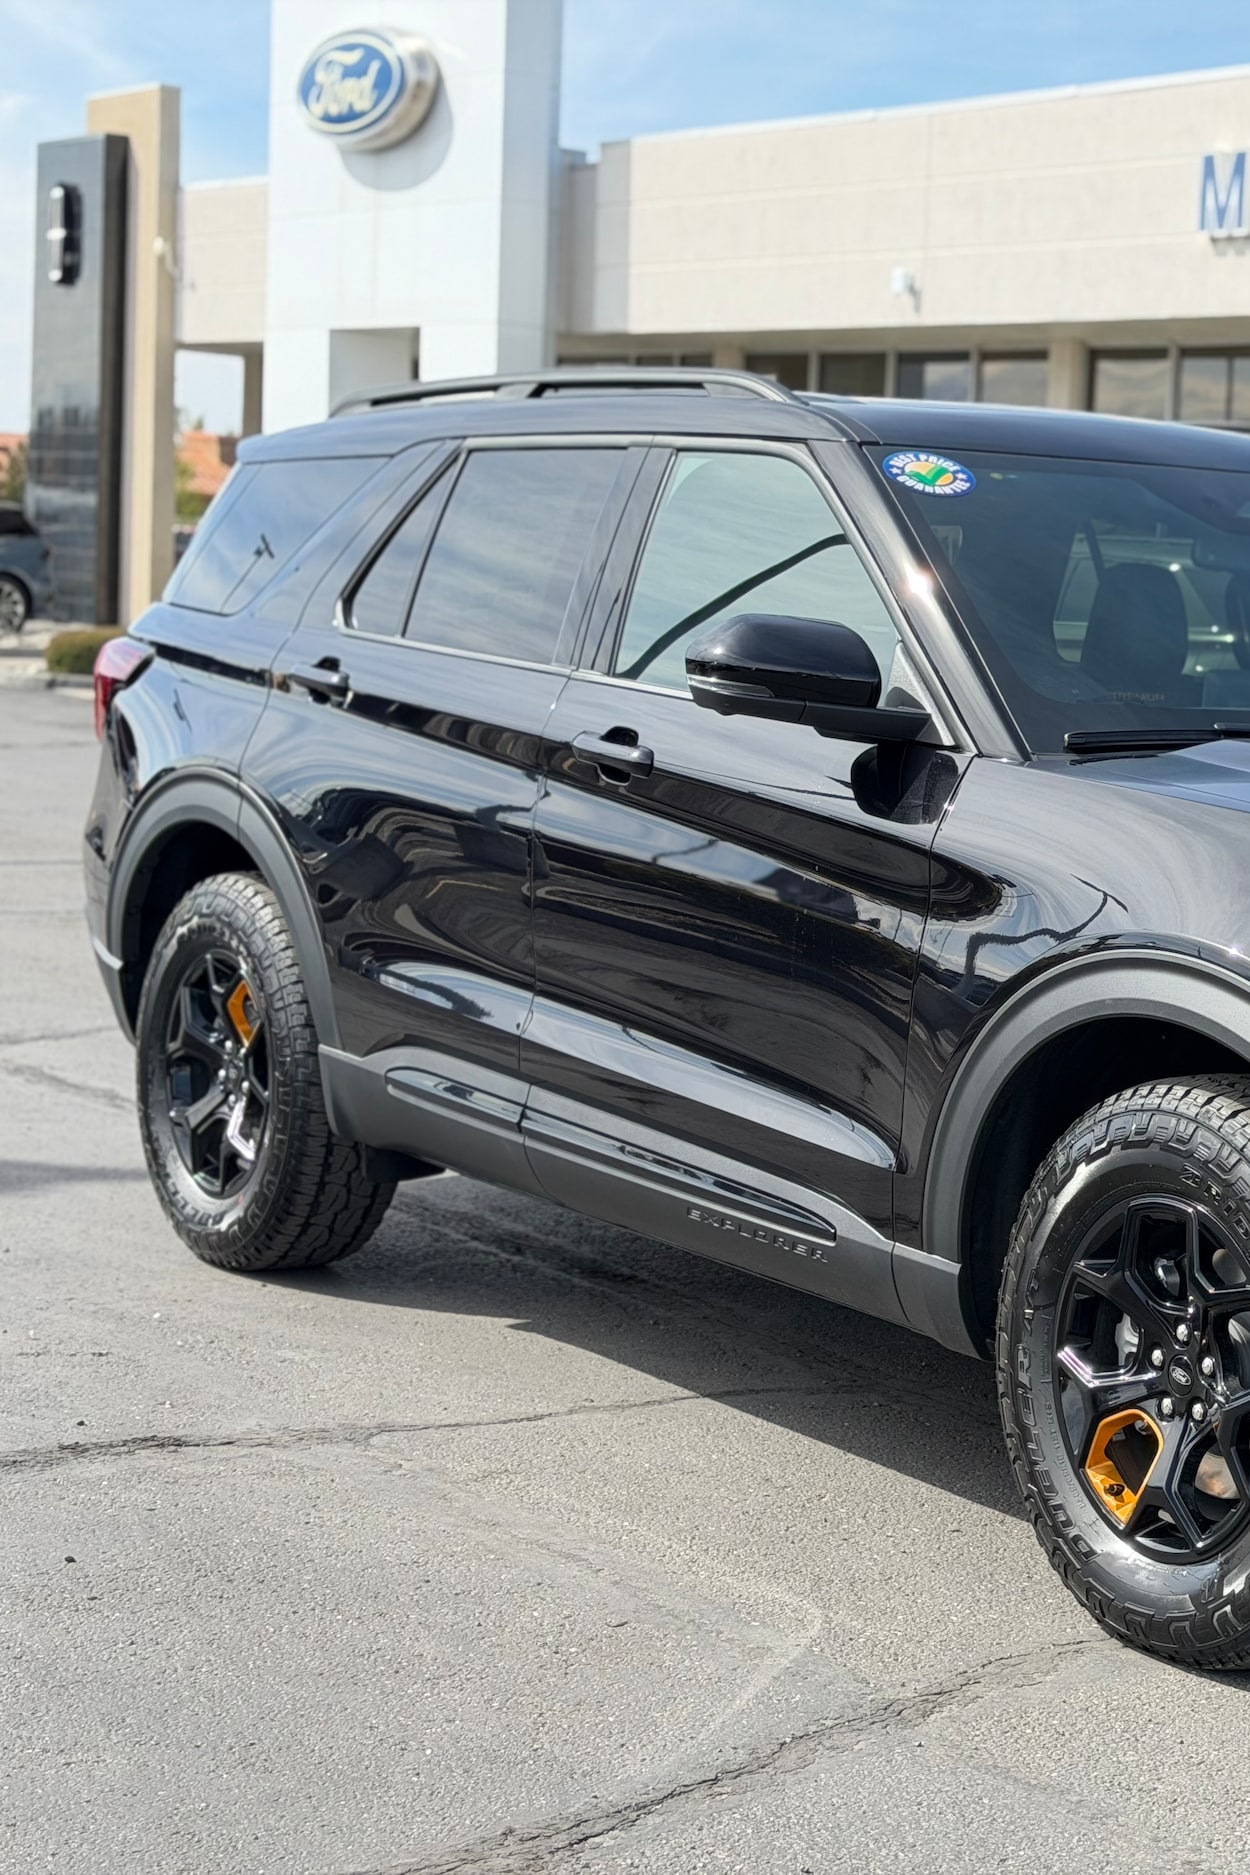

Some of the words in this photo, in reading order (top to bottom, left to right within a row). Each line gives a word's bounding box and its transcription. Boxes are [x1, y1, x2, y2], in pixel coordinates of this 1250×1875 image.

[307, 47, 382, 118] Ford
[889, 453, 917, 468] BEST
[918, 454, 962, 472] PRICE
[896, 475, 971, 495] GUARANTEE
[687, 1206, 828, 1263] EXPLORER
